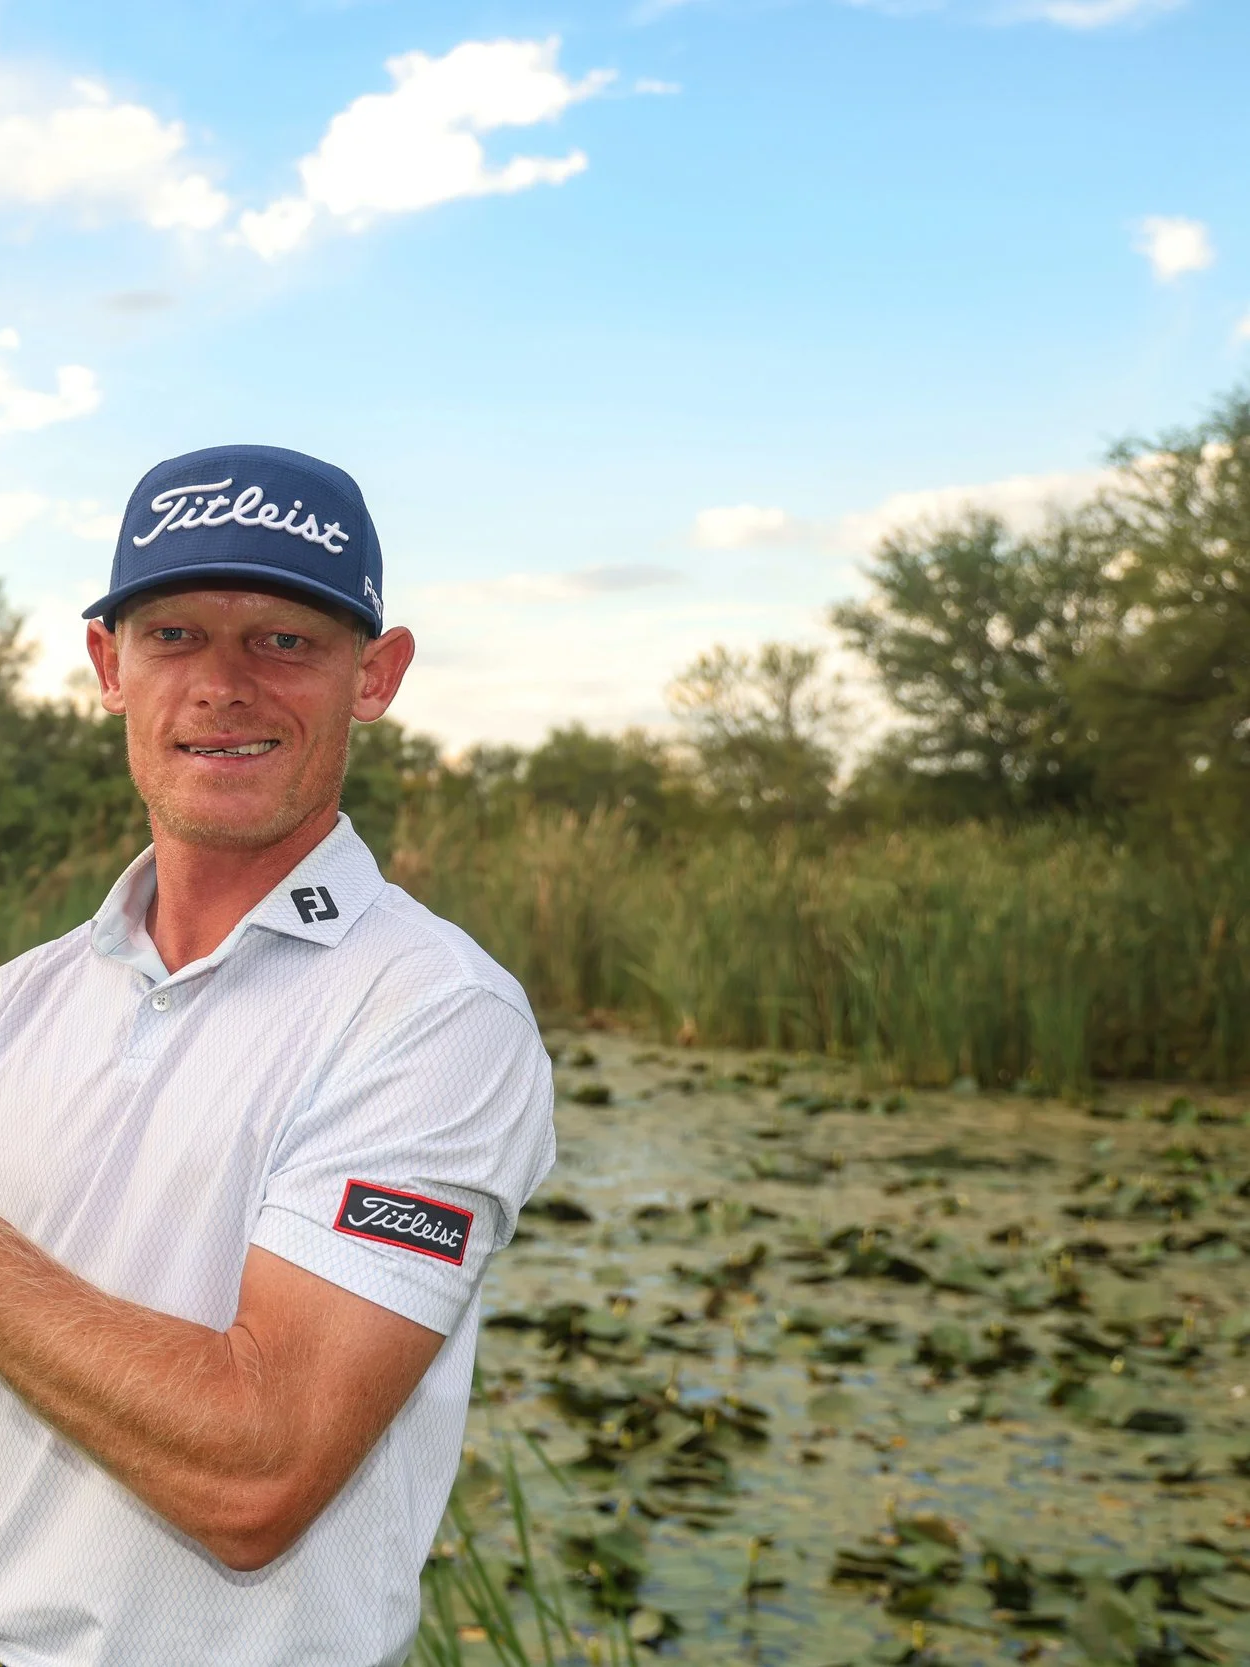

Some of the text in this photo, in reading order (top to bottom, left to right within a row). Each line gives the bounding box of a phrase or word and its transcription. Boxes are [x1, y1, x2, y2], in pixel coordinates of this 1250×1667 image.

[132, 477, 350, 555] Titleist
[290, 886, 340, 924] FJ
[347, 1197, 463, 1248] Titleist
